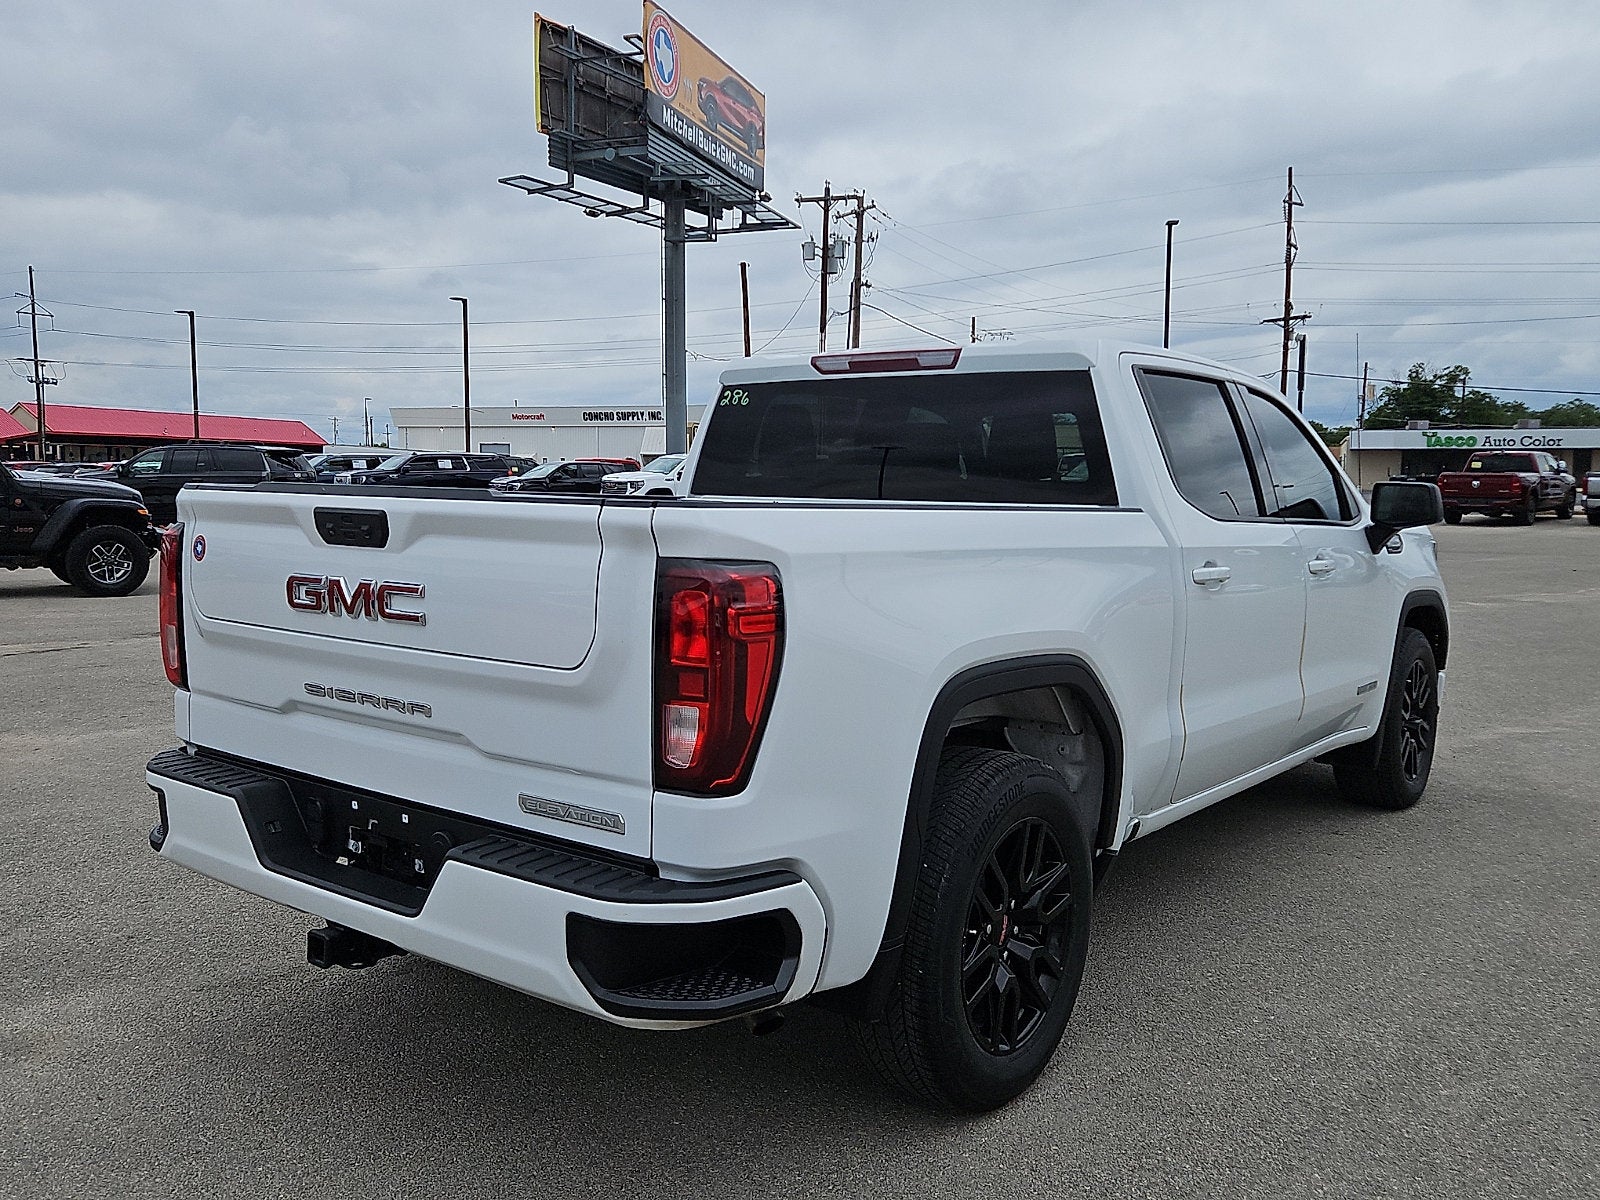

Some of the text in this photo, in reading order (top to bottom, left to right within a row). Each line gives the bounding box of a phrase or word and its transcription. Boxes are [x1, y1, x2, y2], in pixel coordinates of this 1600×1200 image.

[662, 104, 755, 181] MitchellBuickGMC.com
[720, 389, 750, 406] 286
[511, 413, 545, 421] Motorcraft
[583, 411, 665, 422] CONCHO SUPPLY, INC.
[1422, 431, 1564, 448] TASCO Auto Color
[286, 573, 427, 626] GMC
[303, 682, 433, 718] SIERRA
[526, 799, 615, 828] ELEVATION
